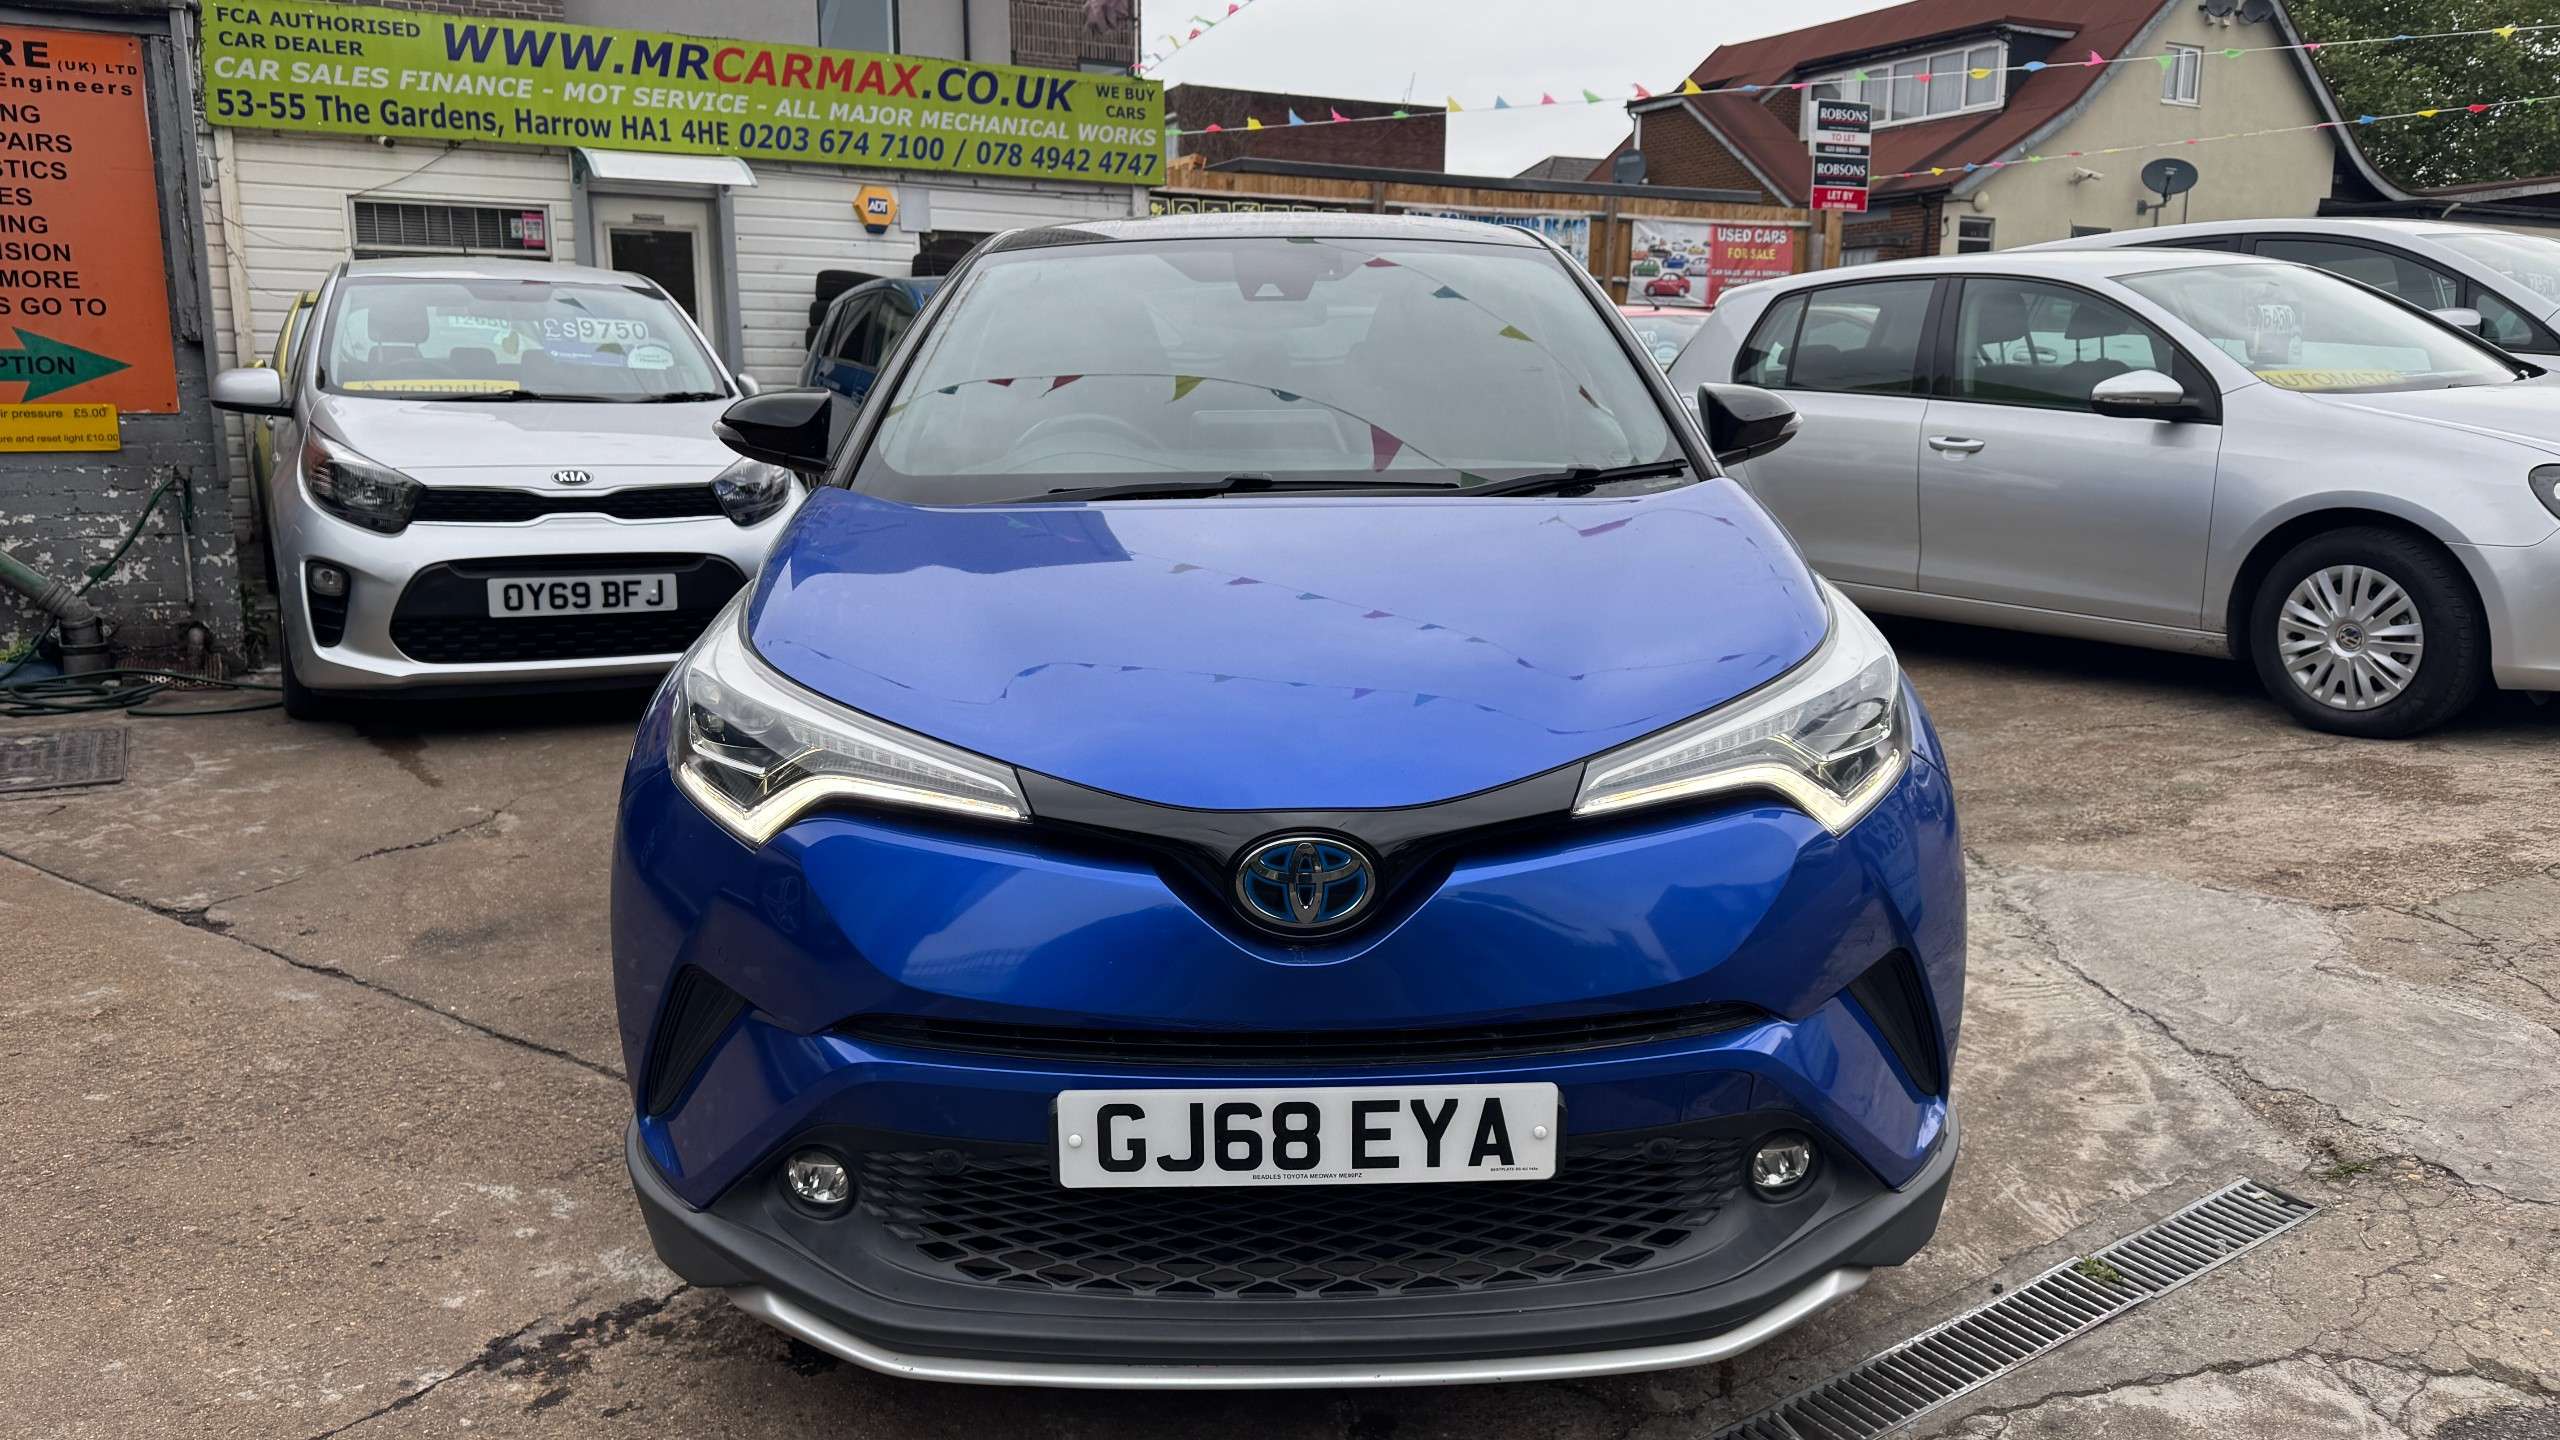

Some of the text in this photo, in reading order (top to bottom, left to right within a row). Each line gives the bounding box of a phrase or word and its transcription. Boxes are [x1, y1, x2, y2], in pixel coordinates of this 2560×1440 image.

[216, 7, 421, 38] FCA AUTHORISED
[218, 31, 364, 56] CAR DEALER
[57, 60, 97, 75] (UK)
[105, 63, 138, 76] LTD
[443, 23, 1077, 112] WWW.MRCARMAX.CO.UK
[214, 56, 280, 81] CAR
[290, 62, 389, 89] SALES
[400, 70, 533, 98] FINANCE
[563, 82, 626, 106] MOT
[632, 87, 749, 114] SERVICE
[775, 98, 821, 120] ALL
[829, 102, 912, 127] MAJOR
[920, 110, 1069, 140] MECHANICAL
[1078, 123, 1157, 146] WORKS
[1096, 85, 1156, 102] WE BUY
[1106, 105, 1146, 120] CARS
[1820, 108, 1868, 122] ROBSONS
[216, 88, 306, 120] 53-55
[315, 94, 370, 125] The
[380, 99, 504, 138] Gardens,
[514, 108, 612, 138] Harrow
[621, 115, 671, 143] HA1
[681, 119, 729, 146] 4HE
[739, 123, 809, 151] 0203
[819, 129, 869, 156] 674
[880, 133, 945, 161] 7100
[976, 141, 1023, 168] 078
[1031, 146, 1090, 172] 4942
[1098, 150, 1158, 177] 4747
[0, 160, 68, 180] TICS
[1817, 163, 1866, 176] ROBSONS
[1827, 190, 1854, 200] LET BY
[868, 200, 887, 213] ADT
[1717, 227, 1788, 244] USED CARS
[1728, 247, 1776, 260] FOR SALE
[20, 297, 62, 316] GO
[69, 298, 107, 317] TO
[12, 409, 63, 420] pressure
[73, 408, 106, 418] £5.00
[64, 433, 84, 444] light
[558, 471, 587, 482] KIA
[503, 579, 664, 611] OY69 BFJ
[1096, 1097, 1515, 1173] GJ68 EYA
